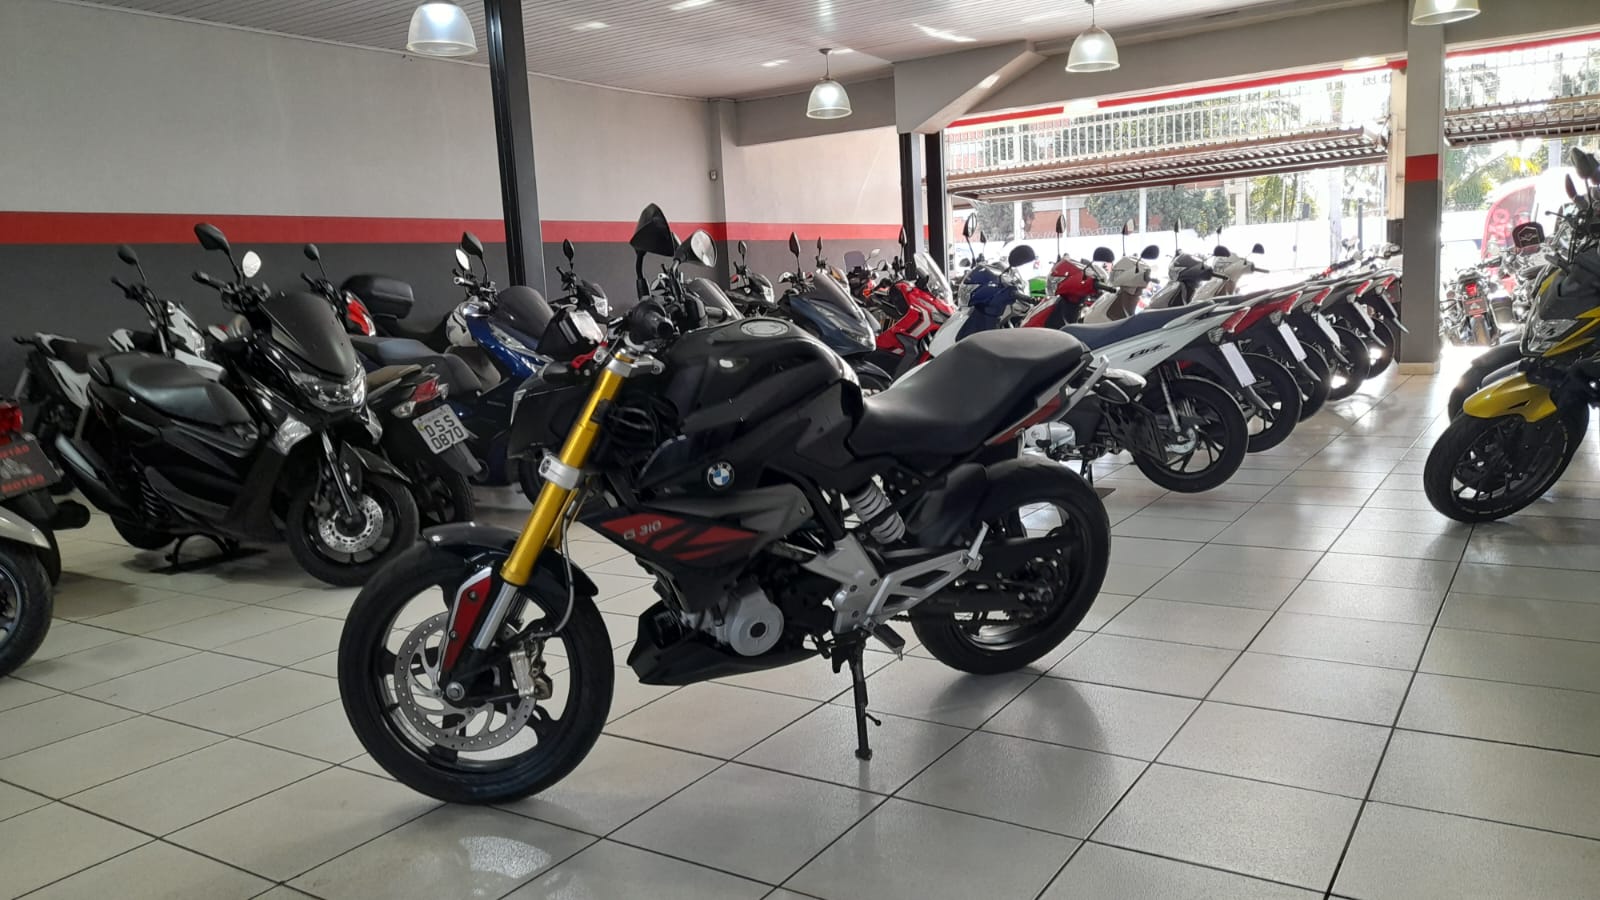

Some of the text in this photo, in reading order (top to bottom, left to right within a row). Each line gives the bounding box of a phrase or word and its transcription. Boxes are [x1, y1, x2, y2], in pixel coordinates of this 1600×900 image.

[424, 415, 455, 438] DSS
[430, 425, 465, 450] 0870
[640, 519, 662, 536] 310
